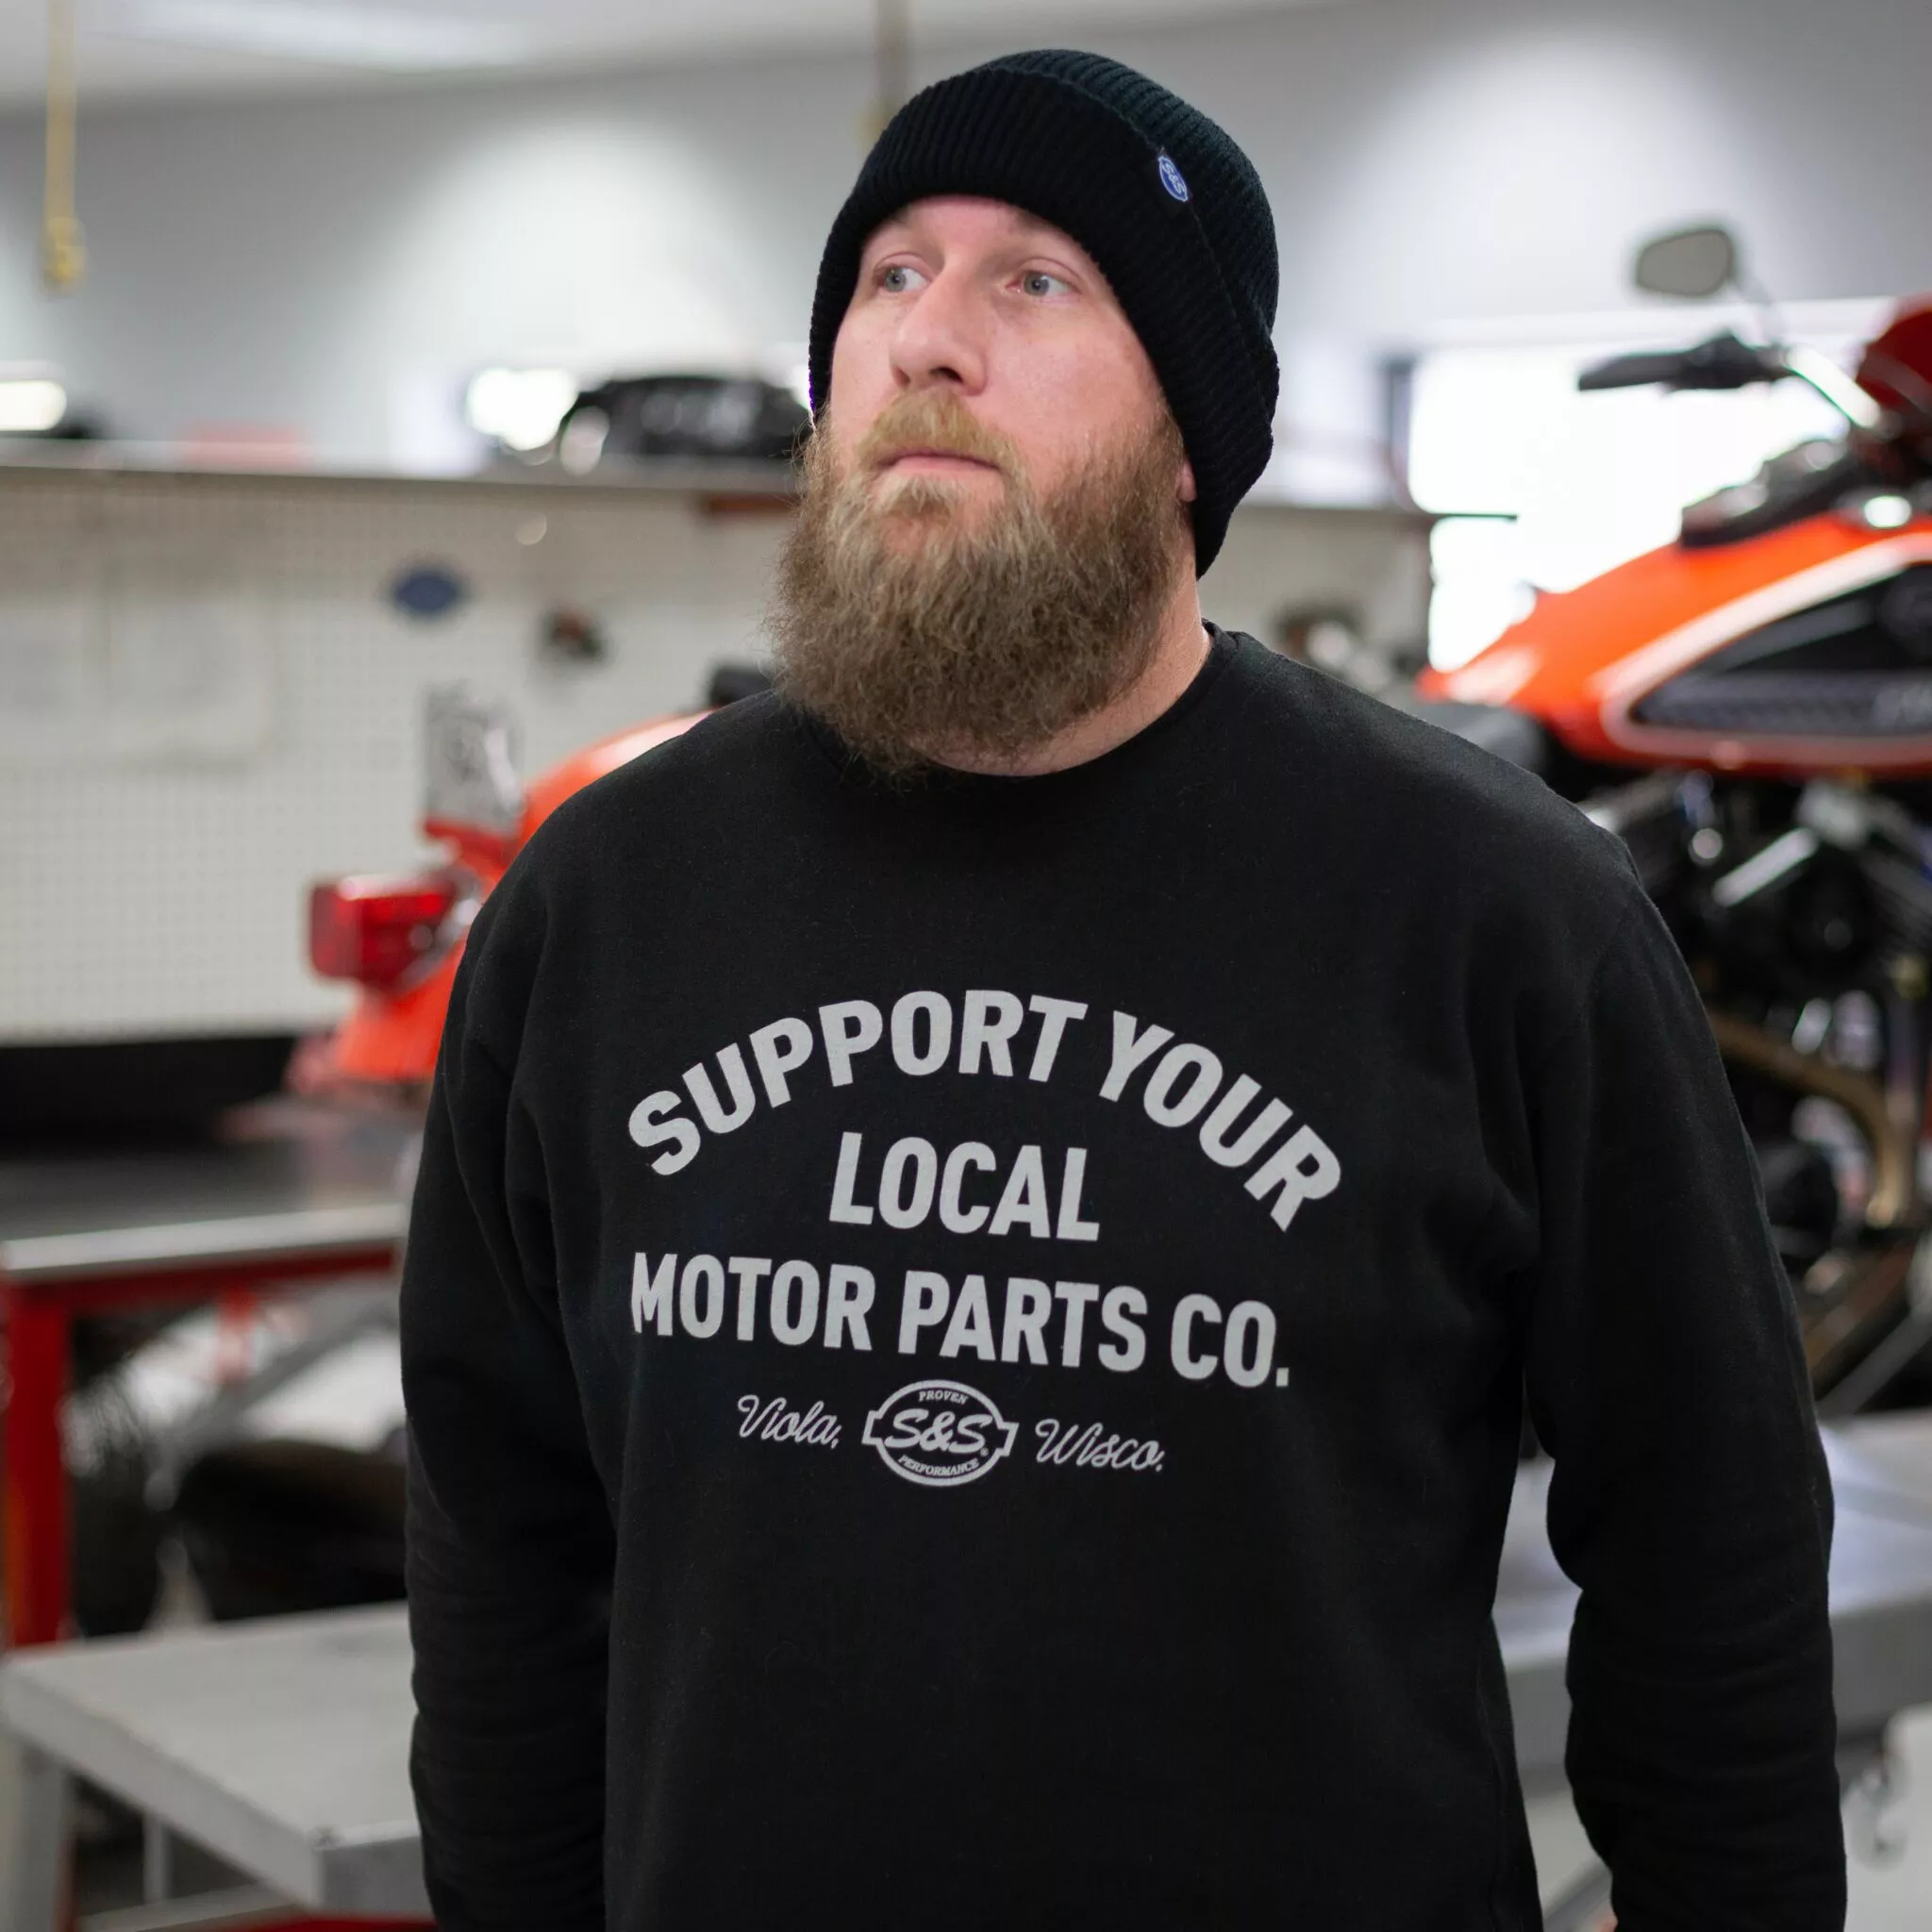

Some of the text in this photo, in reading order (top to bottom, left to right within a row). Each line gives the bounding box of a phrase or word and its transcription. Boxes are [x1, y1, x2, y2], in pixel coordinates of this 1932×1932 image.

[628, 990, 1341, 1231] SUPPORT YOUR
[829, 1132, 1099, 1241] LOCAL
[631, 1253, 1290, 1388] MOTOR PARTS CO.
[738, 1394, 842, 1449] Viola,
[918, 1390, 970, 1405] PROVEN
[897, 1454, 980, 1478] PERFORMANCE
[1036, 1418, 1165, 1472] Wisco.
